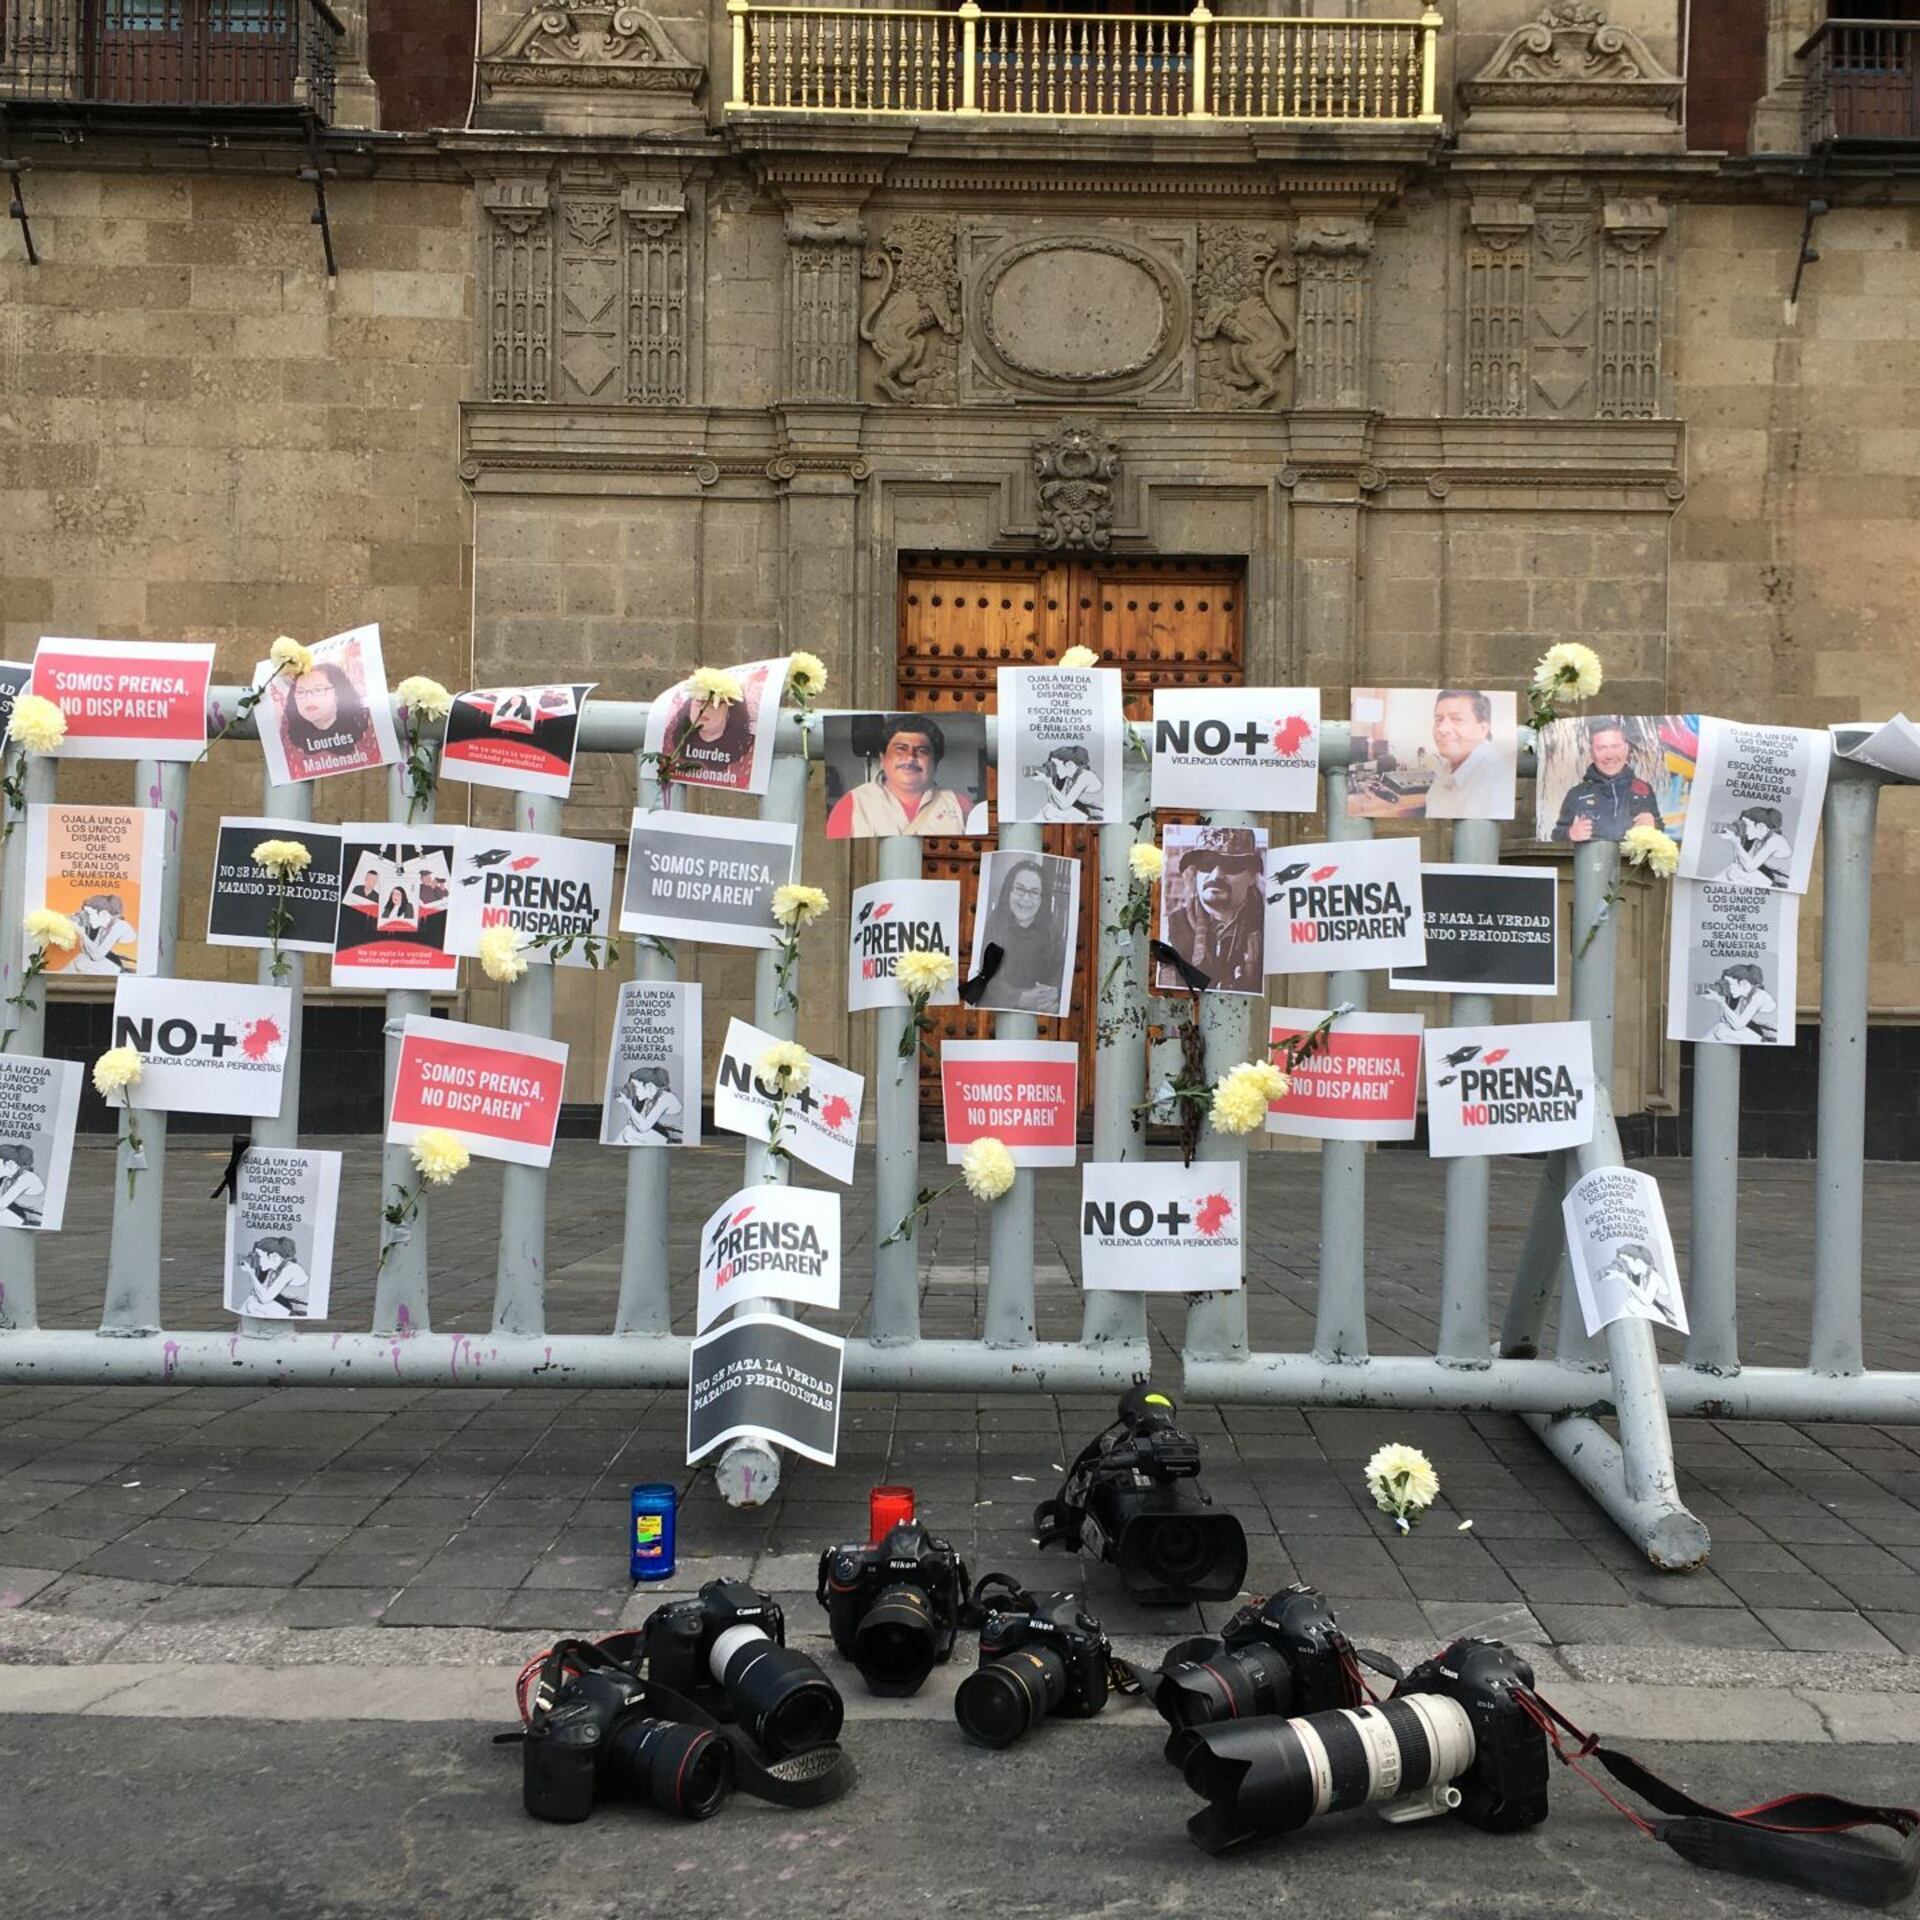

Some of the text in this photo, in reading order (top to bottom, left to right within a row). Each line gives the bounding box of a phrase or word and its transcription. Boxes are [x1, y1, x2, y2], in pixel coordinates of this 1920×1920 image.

[1060, 675, 1075, 683] UN
[1032, 683, 1050, 691] LOS
[1037, 691, 1082, 700] DISPAROS
[60, 697, 82, 717] NO
[1051, 699, 1070, 708] QUE
[1027, 707, 1093, 717] ESCUCHEMOS
[1038, 716, 1083, 724] SEAN LOS
[1030, 723, 1092, 733] DE NUESTRAS
[306, 732, 354, 752] Lourdes
[1735, 736, 1754, 745] LOS
[1765, 733, 1780, 743] UN
[685, 744, 731, 763] Lourdes
[1740, 744, 1788, 758] DISPAROS
[303, 749, 368, 773] Maldonado
[1171, 756, 1316, 769] VIOLENCIA CONTRA PERIODISTAS
[1753, 755, 1774, 765] QUE
[1727, 761, 1796, 777] ESCUCHEMOS
[1737, 771, 1784, 785] SEAN LOS
[1726, 778, 1791, 795] DE NUESTRAS
[98, 816, 113, 825] UN
[66, 824, 86, 833] LOS
[71, 834, 121, 843] DISPAROS
[86, 843, 107, 852] QUE
[60, 851, 130, 862] ESCUCHEMOS
[72, 861, 119, 870] SEAN LOS
[62, 869, 128, 880] DE NUESTRAS
[220, 865, 235, 877] NO
[236, 867, 250, 878] SE
[708, 860, 774, 886] PRENSA,
[217, 881, 340, 903] MATANDO PERIODIS
[651, 878, 673, 897] NO
[1739, 886, 1755, 895] UN
[484, 872, 600, 923] PRENSA,
[1289, 881, 1411, 921] PRENSA,
[1708, 895, 1727, 903] LOS
[1713, 904, 1760, 914] DISPAROS
[1440, 913, 1474, 925] MATA
[1477, 914, 1494, 926] LA
[1497, 915, 1550, 928] VERDAD
[1727, 913, 1746, 922] QUE
[1702, 922, 1769, 932] ESCUCHEMOS
[1459, 931, 1551, 944] PERIODISTAS
[1713, 931, 1758, 941] SEAN LOS
[1702, 939, 1767, 950] DE NUESTRAS
[633, 1016, 653, 1026] QUE
[646, 1035, 665, 1044] LOS
[185, 1057, 224, 1069] CONTRA
[226, 1060, 282, 1073] PERIODISTAS
[15, 1065, 31, 1075] UN
[33, 1067, 51, 1077] DÍA
[1292, 1077, 1313, 1097] NO
[1461, 1065, 1583, 1104] PRENSA,
[421, 1086, 444, 1107] NO
[12, 1112, 33, 1122] LOS
[967, 1107, 986, 1126] NO
[273, 1158, 288, 1167] UN
[245, 1166, 261, 1175] LOS
[249, 1175, 297, 1186] DISPAROS
[1607, 1174, 1623, 1185] UN
[259, 1185, 281, 1194] QUE
[1583, 1187, 1601, 1201] LOS
[241, 1192, 305, 1205] ESCUCHEMOS
[1588, 1192, 1634, 1206] DISPAROS
[1603, 1198, 1624, 1207] QUE
[247, 1203, 293, 1213] SEAN LOS
[251, 1212, 302, 1223] NUESTRAS
[1585, 1206, 1646, 1225] ESCUCHEMOS
[1595, 1215, 1640, 1226] SEAN LOS
[1590, 1223, 1648, 1239] DE NUESTRAS
[717, 1221, 829, 1270] PRENSA,
[1099, 1238, 1239, 1248] VIOLENCIA CONTRA PERIODISTAS
[695, 1358, 834, 1397] NO SE MATA LA VERDAD
[694, 1373, 834, 1412] MATANDO PERIODISTAS
[890, 1560, 917, 1569] Nikon
[736, 1606, 762, 1616] Canon
[1029, 1619, 1054, 1631] Nikon
[1439, 1665, 1459, 1680] Canon
